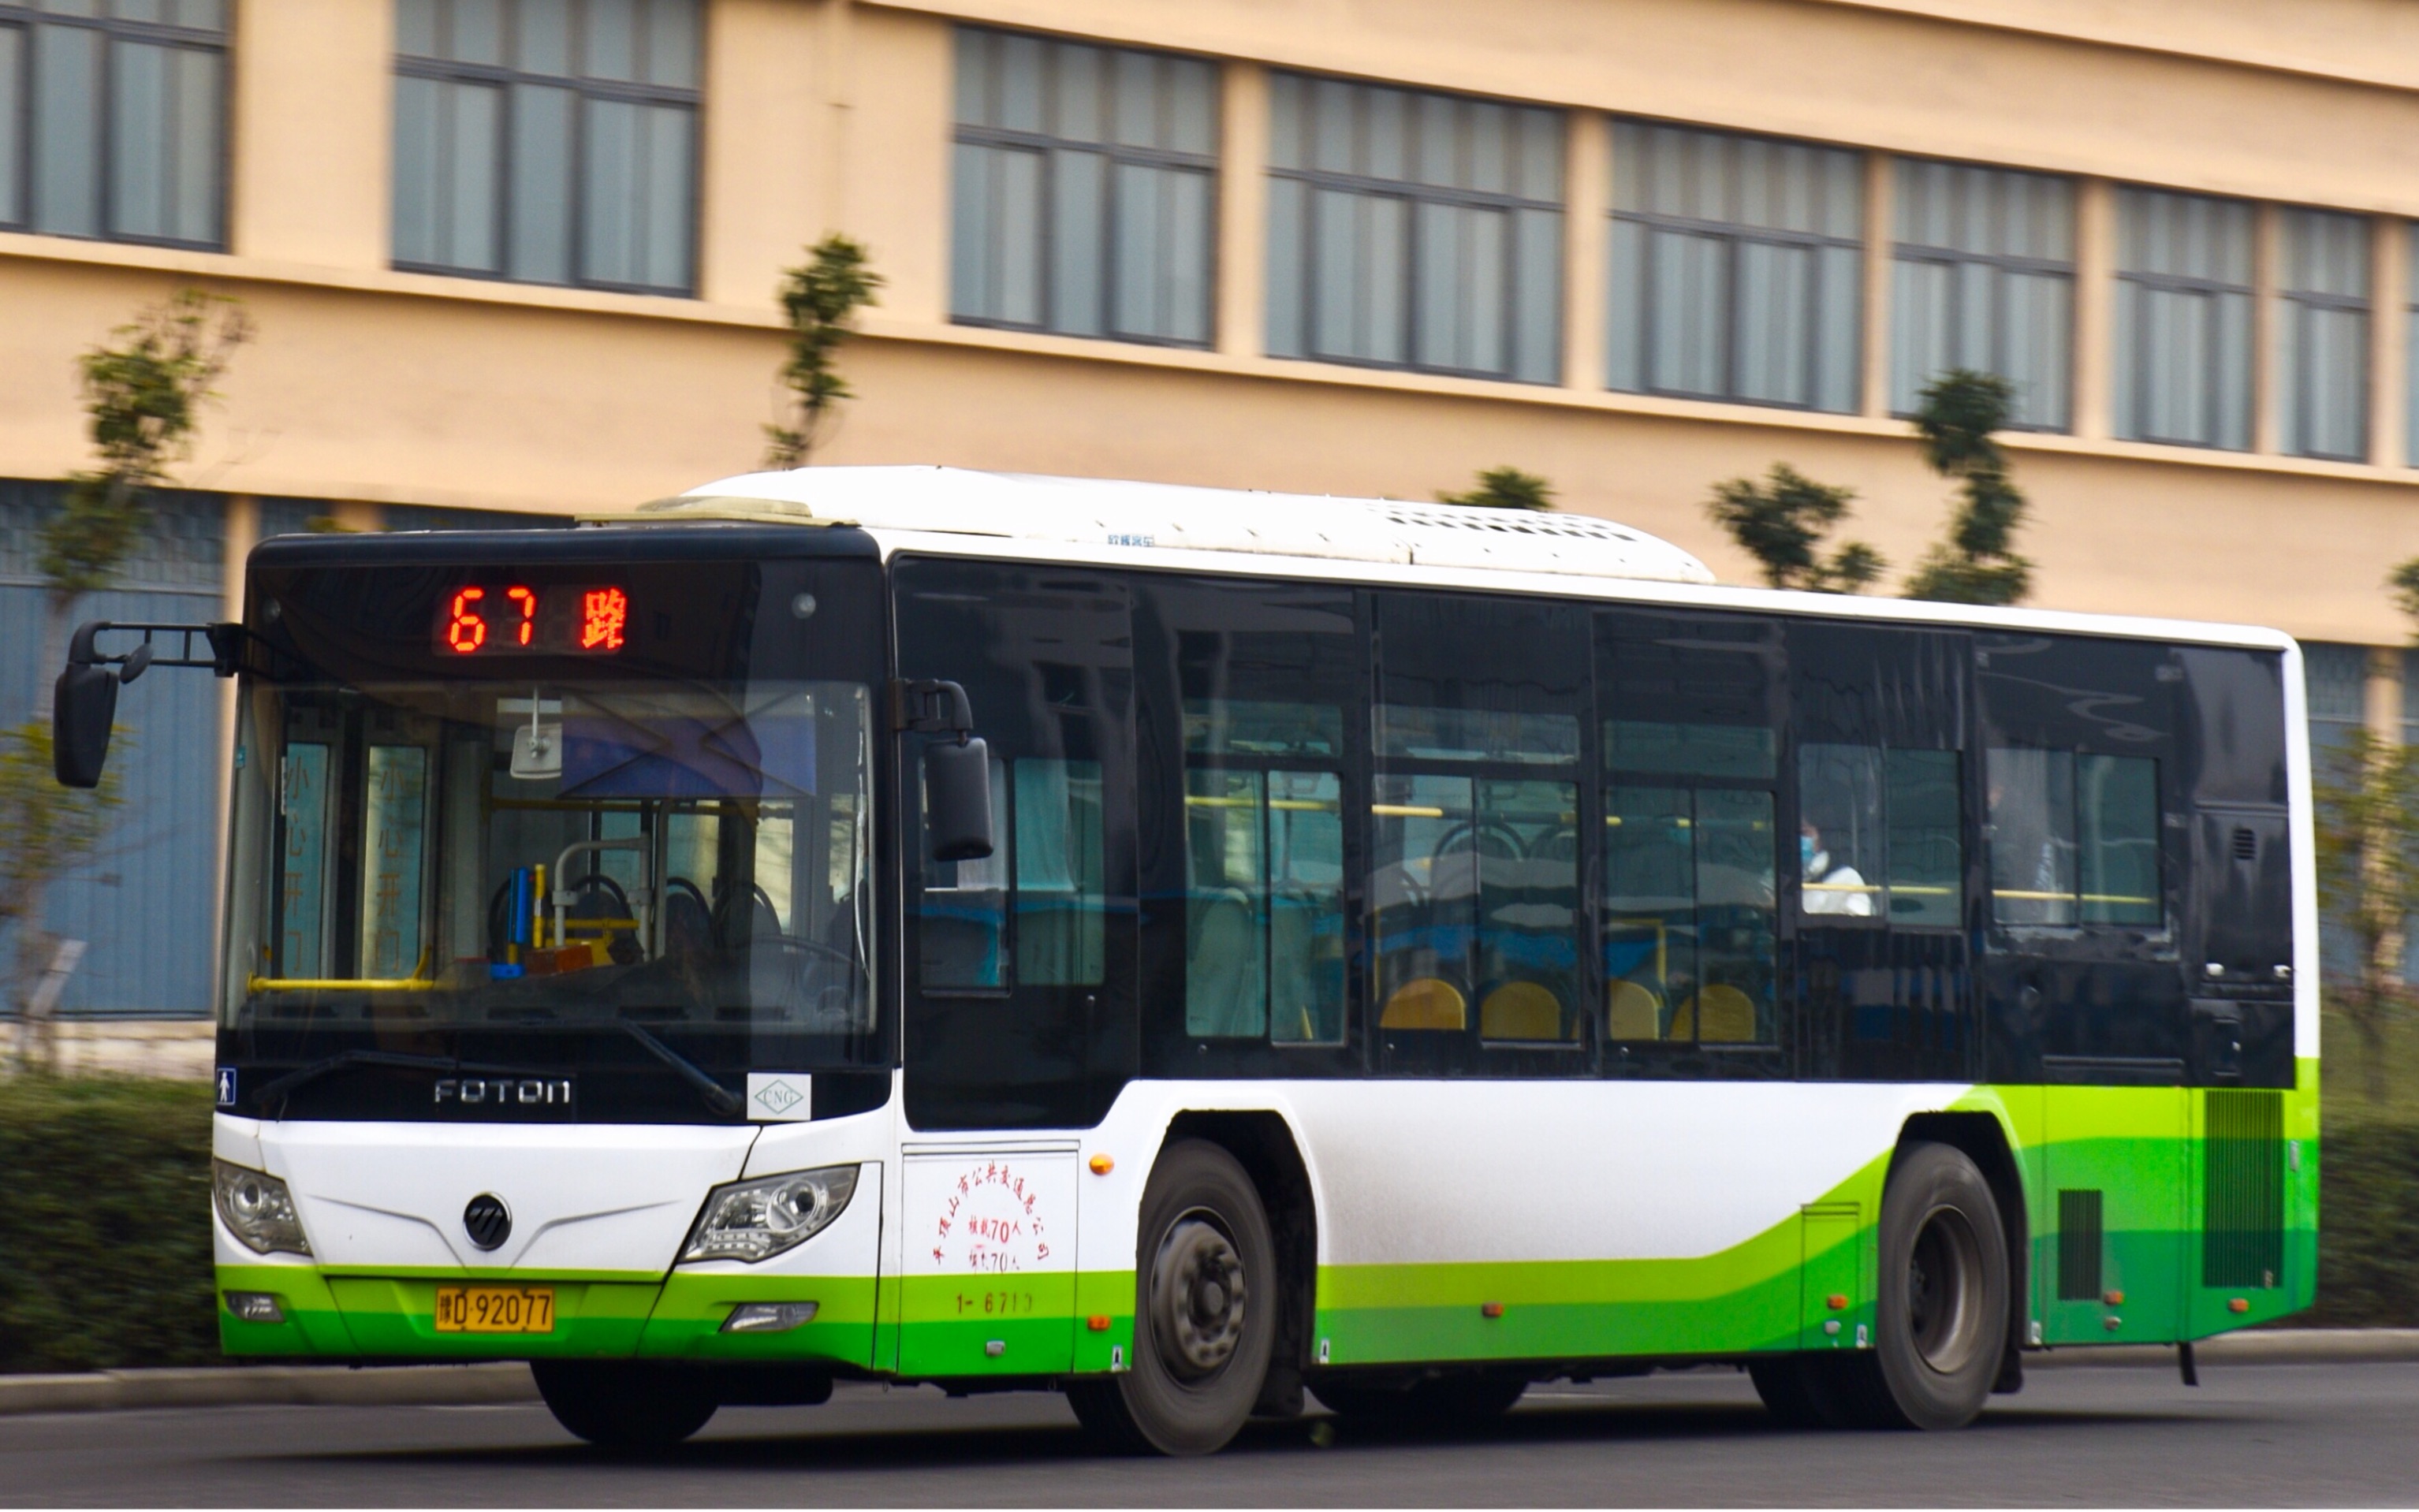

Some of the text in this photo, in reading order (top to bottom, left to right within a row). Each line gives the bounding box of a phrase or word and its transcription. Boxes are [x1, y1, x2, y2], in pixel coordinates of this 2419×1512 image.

[449, 587, 625, 653] 67 路
[375, 757, 405, 973] 小心开门
[434, 1079, 570, 1104] FOTON
[762, 1089, 793, 1104] CNG
